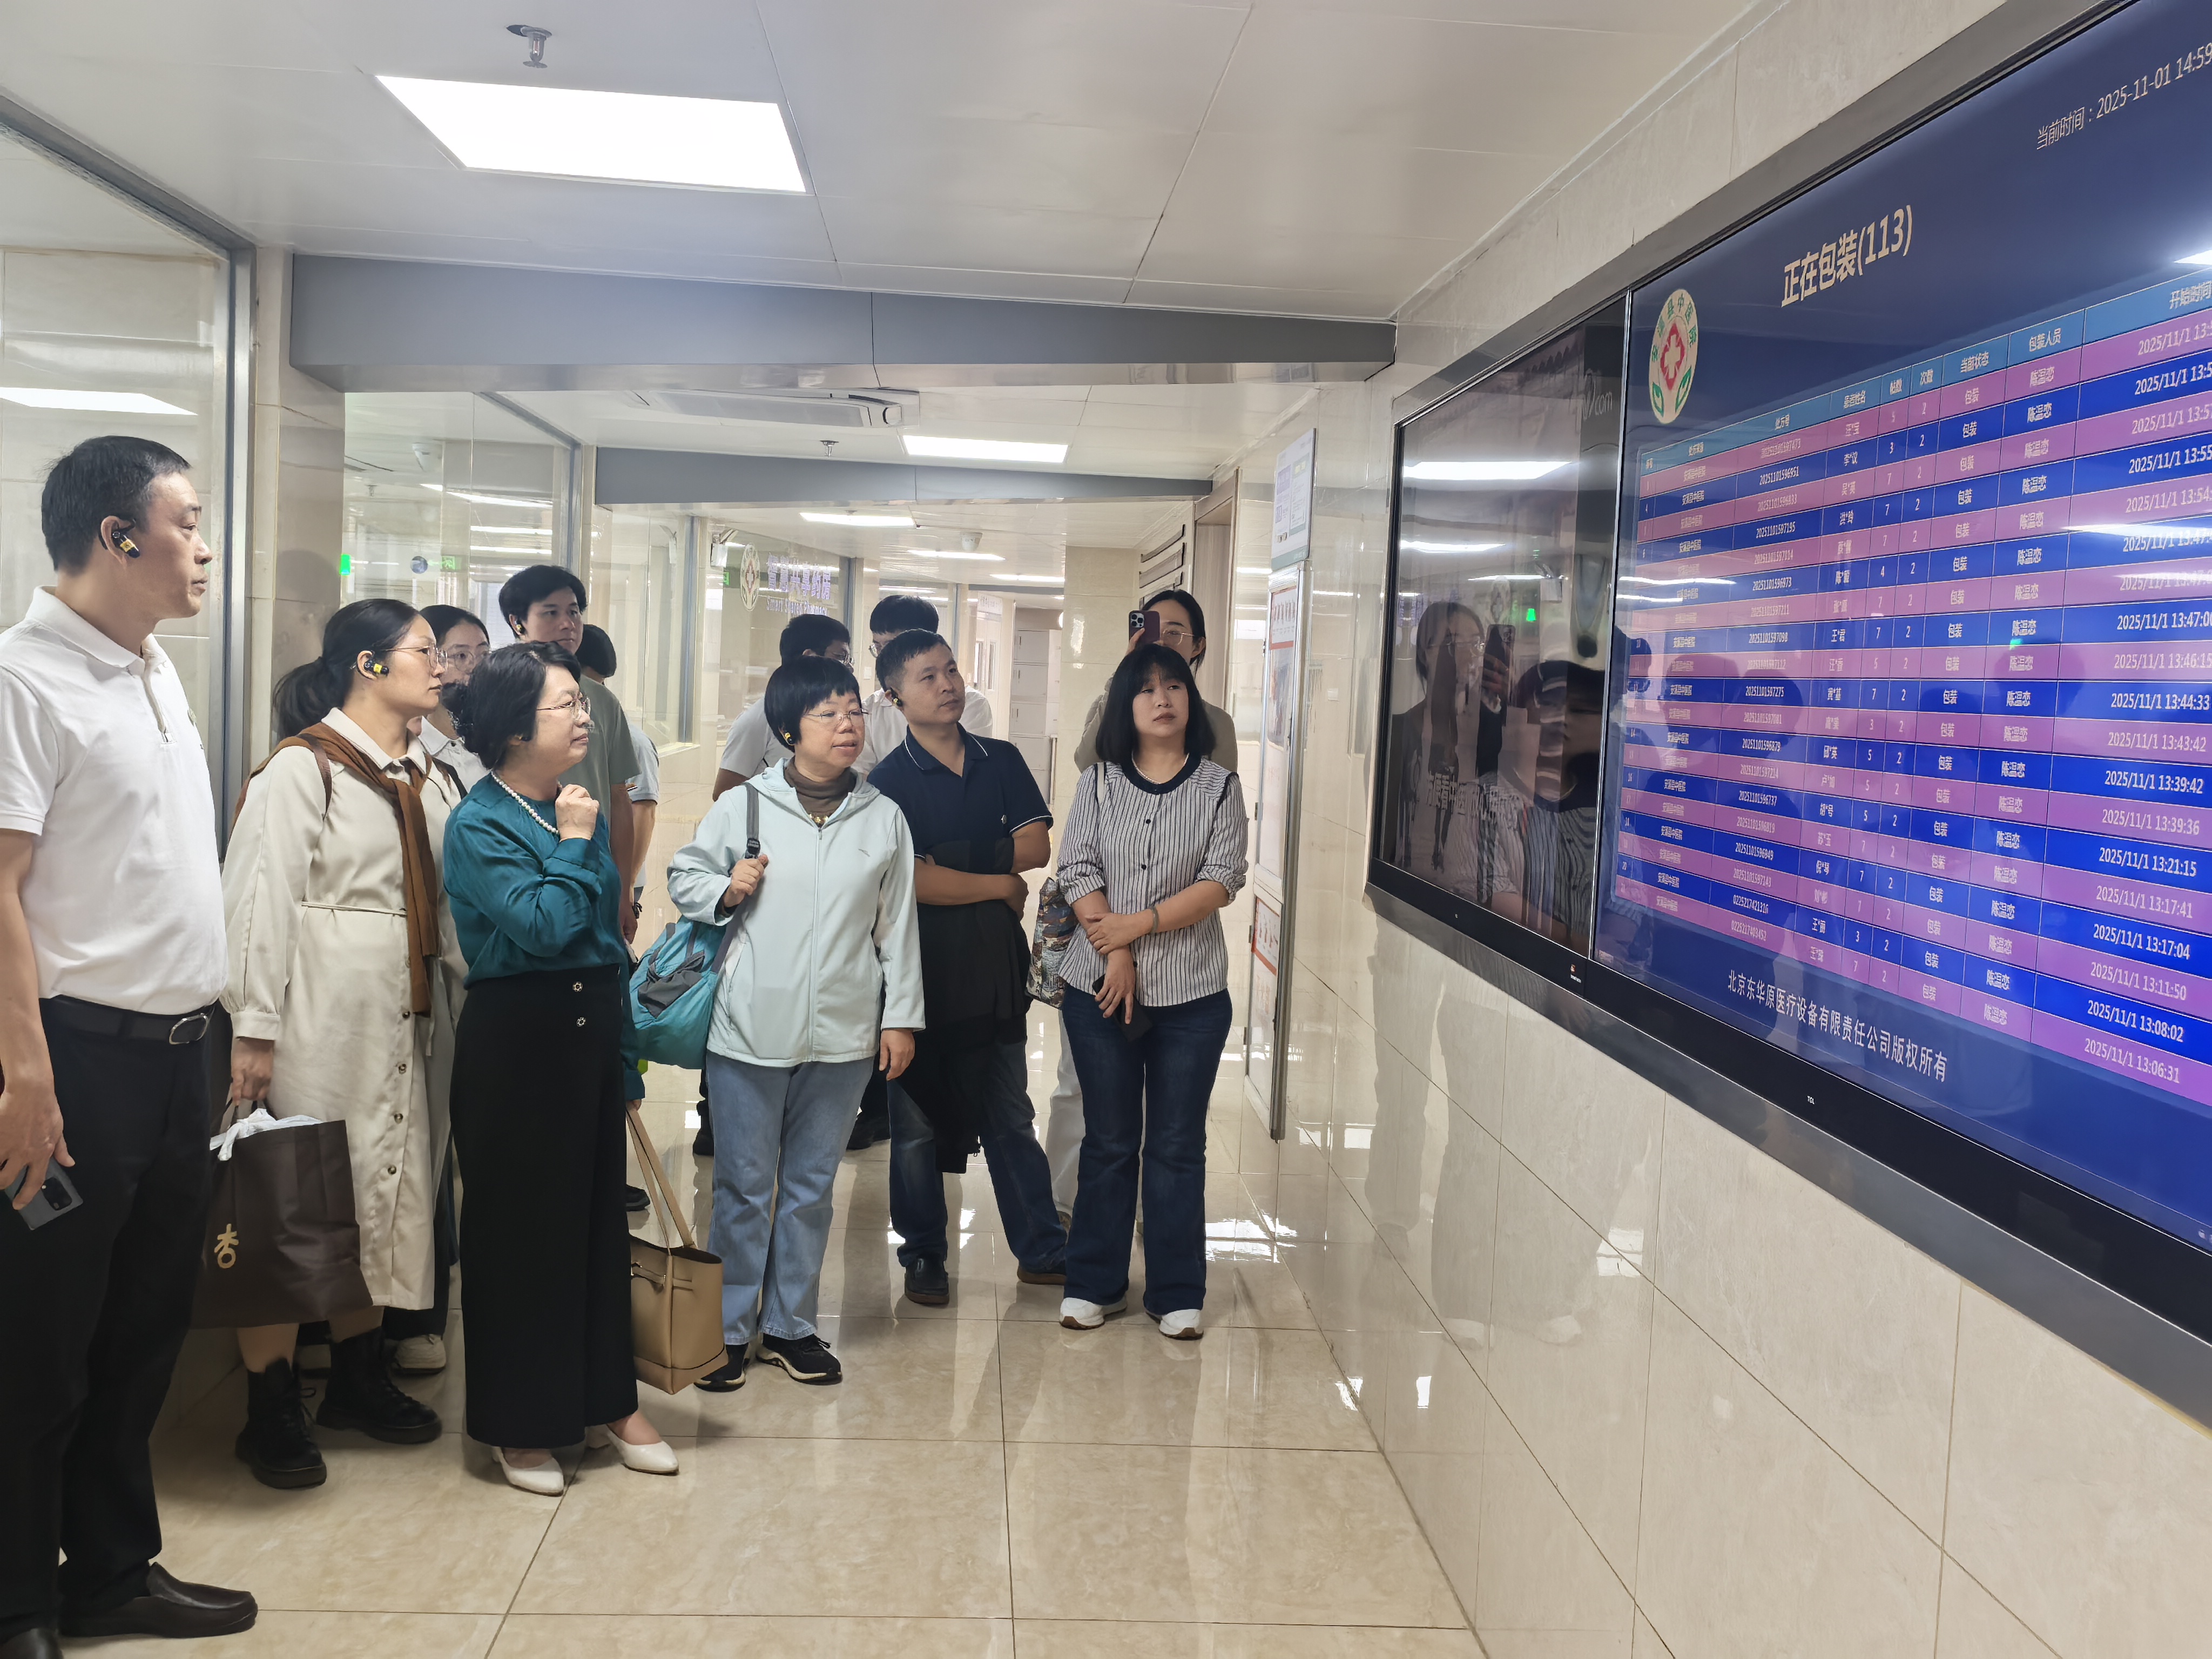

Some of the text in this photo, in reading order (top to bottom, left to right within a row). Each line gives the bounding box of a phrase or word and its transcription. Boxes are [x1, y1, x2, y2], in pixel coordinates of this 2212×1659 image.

[1781, 205, 1913, 308] 正在包装(113)
[1919, 368, 1934, 387] 次数
[1960, 350, 1990, 374] 当前状态
[2028, 327, 2062, 354] 包装人员
[1921, 402, 1926, 415] 2
[1964, 386, 1980, 405] 包装
[2137, 327, 2190, 357] 2025/11/1
[1889, 442, 1893, 455] 3
[1919, 434, 1924, 447] 2
[1962, 420, 1977, 439] 包装
[2134, 368, 2187, 396] 2025/11/1
[1917, 466, 1922, 480] 2
[1959, 454, 1975, 472] 包装
[2131, 409, 2184, 436] 2025/11/1
[1885, 504, 1889, 516] 7
[1914, 498, 1920, 511] 2
[1957, 488, 1972, 505] 包装
[2128, 450, 2181, 475] 2025/11/1
[1912, 530, 1918, 543] 2
[1954, 522, 1970, 539] 包装
[2125, 491, 2177, 514] 2025/11/1
[1880, 566, 1885, 578] 4
[1910, 562, 1916, 575] 2
[1952, 556, 1967, 572] 包装
[1908, 594, 1913, 606] 2
[1950, 589, 1965, 605] 包装
[1876, 628, 1881, 639] 7
[1906, 626, 1911, 638] 2
[1947, 623, 1963, 638] 包装
[2116, 613, 2168, 631] 2025/11/1
[1904, 657, 1908, 670] 2
[1945, 656, 1960, 671] 包装
[2113, 653, 2165, 670] 2025/11/1
[1872, 689, 1877, 700] 7
[1901, 689, 1906, 701] 2
[1943, 690, 1958, 705] 包装
[2110, 693, 2162, 710] 2025/11/1
[2164, 694, 2210, 712] 13:44:33
[1899, 720, 1904, 732] 2
[1940, 723, 1955, 738] 包装
[2107, 731, 2159, 750] 2025/11/1
[2161, 734, 2207, 753] 13:43:42
[1867, 749, 1872, 761] 5
[1897, 752, 1902, 764] 2
[1938, 755, 1953, 771] 包装
[2105, 770, 2155, 790] 2025/11/1
[2158, 774, 2203, 795] 13:39:42
[1895, 783, 1900, 795] 2
[1936, 788, 1951, 805] 包装
[2102, 808, 2153, 830] 2025/11/1
[2155, 814, 2200, 837] 13:39:36
[1864, 810, 1868, 822] 5
[1893, 814, 1898, 827] 2
[1933, 820, 1948, 838] 包装
[2099, 846, 2149, 870] 2025/11/1
[2152, 855, 2197, 878] 13:21:15
[1859, 870, 1864, 882] 7
[1888, 876, 1893, 889] 2
[1928, 886, 1944, 903] 包装
[2093, 922, 2143, 949] 2025/11/1
[2146, 934, 2190, 961] 13:17:04
[1890, 845, 1896, 858] 2
[1931, 853, 1946, 871] 包装
[2096, 885, 2146, 909] 2025/11/1
[2149, 894, 2194, 920] 13:17:41
[1856, 930, 1860, 942] 3
[1884, 938, 1889, 951] 2
[1924, 950, 1939, 969] 包装
[2087, 999, 2137, 1028] 2025/11/1
[2139, 1014, 2184, 1043] 13:08:02
[1886, 907, 1891, 920] 2
[1926, 918, 1941, 936] 包装
[2090, 961, 2140, 989] 2025/11/1
[2142, 974, 2187, 1002] 13:11:50
[1728, 969, 1947, 1082] 北京东华原医疗设备有限责任公司版权所有
[1882, 969, 1887, 982] 2
[1921, 983, 1937, 1002] 包装
[2084, 1036, 2134, 1068] 2025/11/1
[2136, 1053, 2181, 1084] 13:06:31
